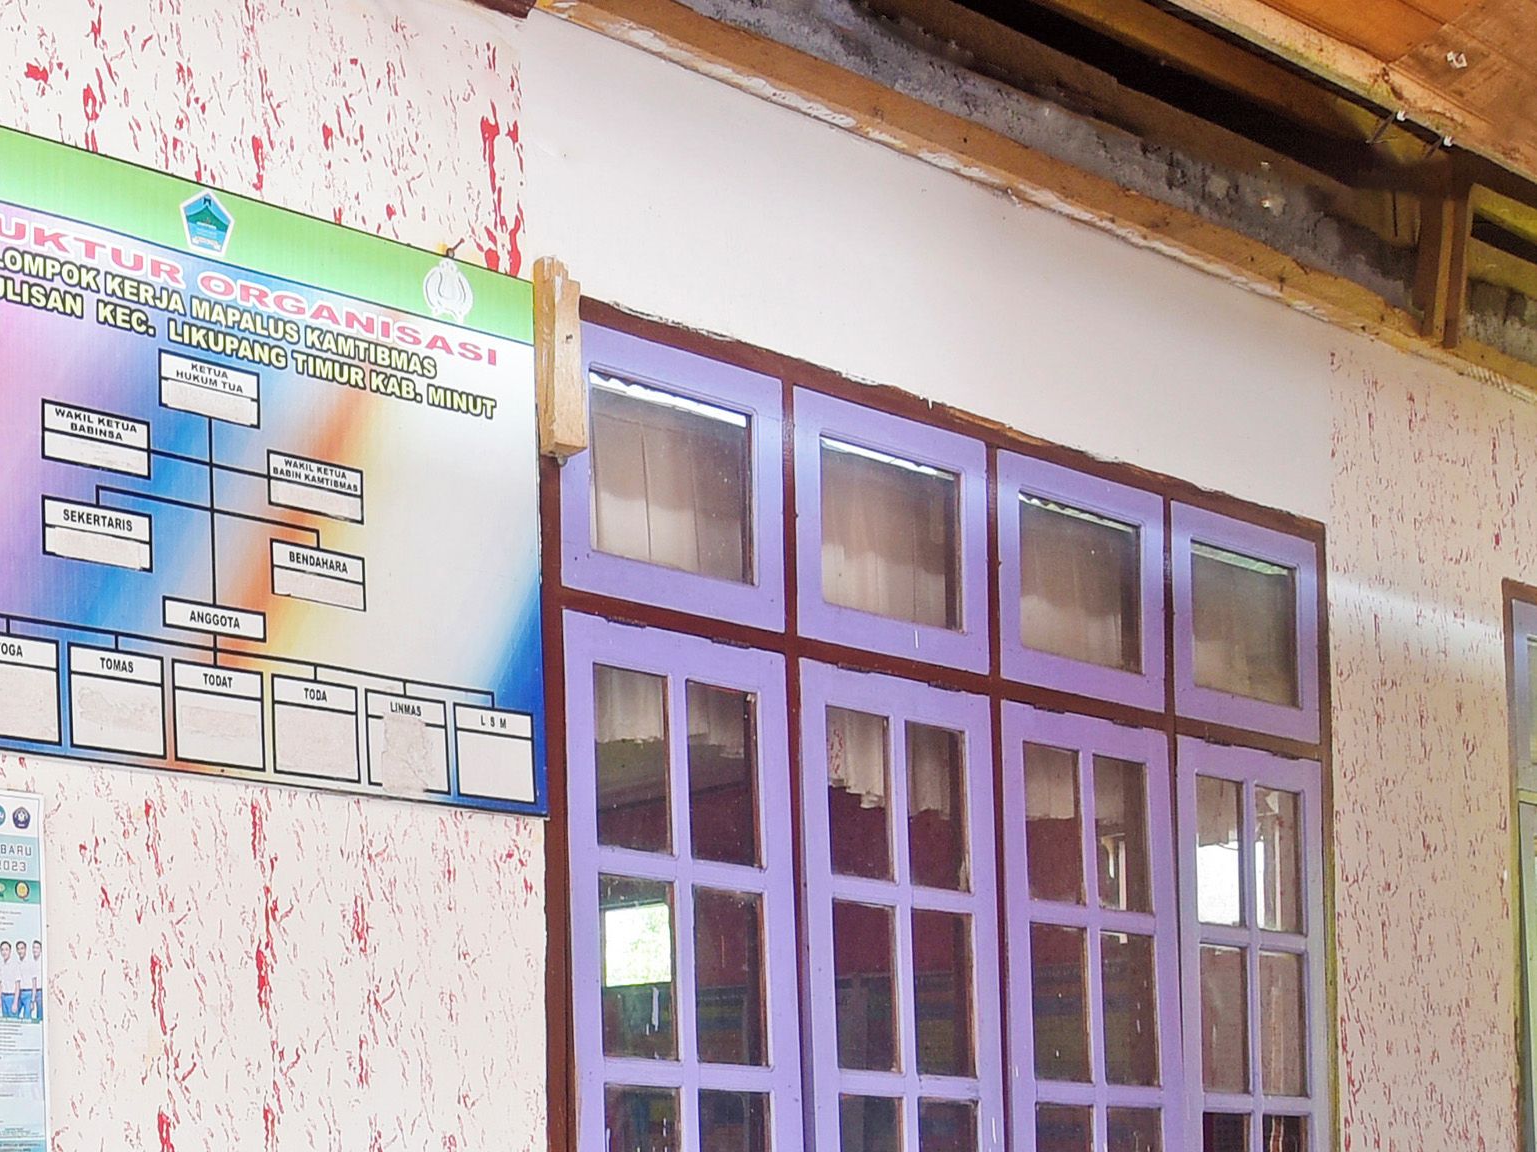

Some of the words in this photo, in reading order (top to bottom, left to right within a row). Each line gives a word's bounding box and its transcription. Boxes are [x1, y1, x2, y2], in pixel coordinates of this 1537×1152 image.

[105, 272, 185, 318] KERJA
[191, 296, 300, 344] MAPALUS
[305, 325, 437, 378] KAMTIBMAS
[199, 272, 498, 366] ORGANISASI
[96, 299, 156, 337] KEC.
[168, 320, 288, 369] LIKUPANG
[292, 351, 366, 390] TIMUR
[369, 367, 423, 402] KAB.
[427, 385, 497, 420] MINUT
[175, 370, 219, 388] HUKUM
[221, 380, 243, 394] TUA
[191, 363, 229, 379] KETUA
[54, 408, 95, 424] WAKIL
[97, 416, 138, 433] KETUA
[70, 422, 124, 441] BABINSA
[272, 466, 302, 481] BABIN
[304, 473, 359, 492] KAMTIBMAS
[284, 458, 314, 472] WAKIL
[317, 465, 347, 480] KETUA
[63, 508, 133, 532] SEKERTARIS
[289, 551, 348, 574] BENDAHARA
[189, 609, 240, 629] ANGGOTA
[100, 657, 134, 673] TOMAS
[203, 673, 233, 689] TODAT
[303, 687, 328, 702] TODA
[390, 700, 422, 717] LINMAS
[0, 844, 32, 856] BARU
